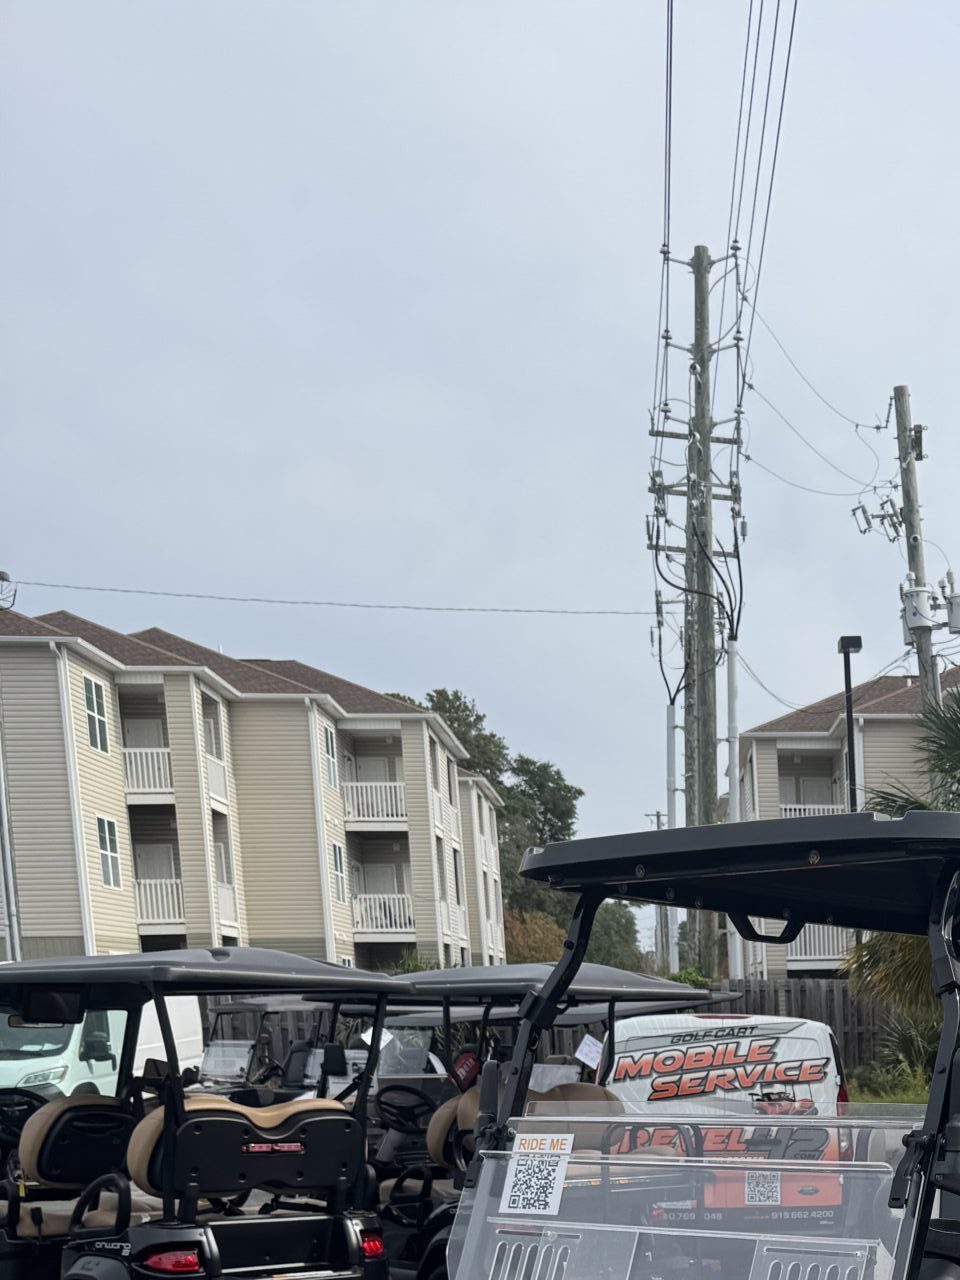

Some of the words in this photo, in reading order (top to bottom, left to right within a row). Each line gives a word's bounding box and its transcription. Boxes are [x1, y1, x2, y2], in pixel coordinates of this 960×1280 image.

[670, 1029, 714, 1044] GOLF
[714, 1026, 758, 1039] CART
[613, 1036, 780, 1082] MOBILE
[647, 1057, 830, 1102] SERVICE
[518, 1138, 547, 1151] RIDE
[549, 1138, 568, 1151] ME
